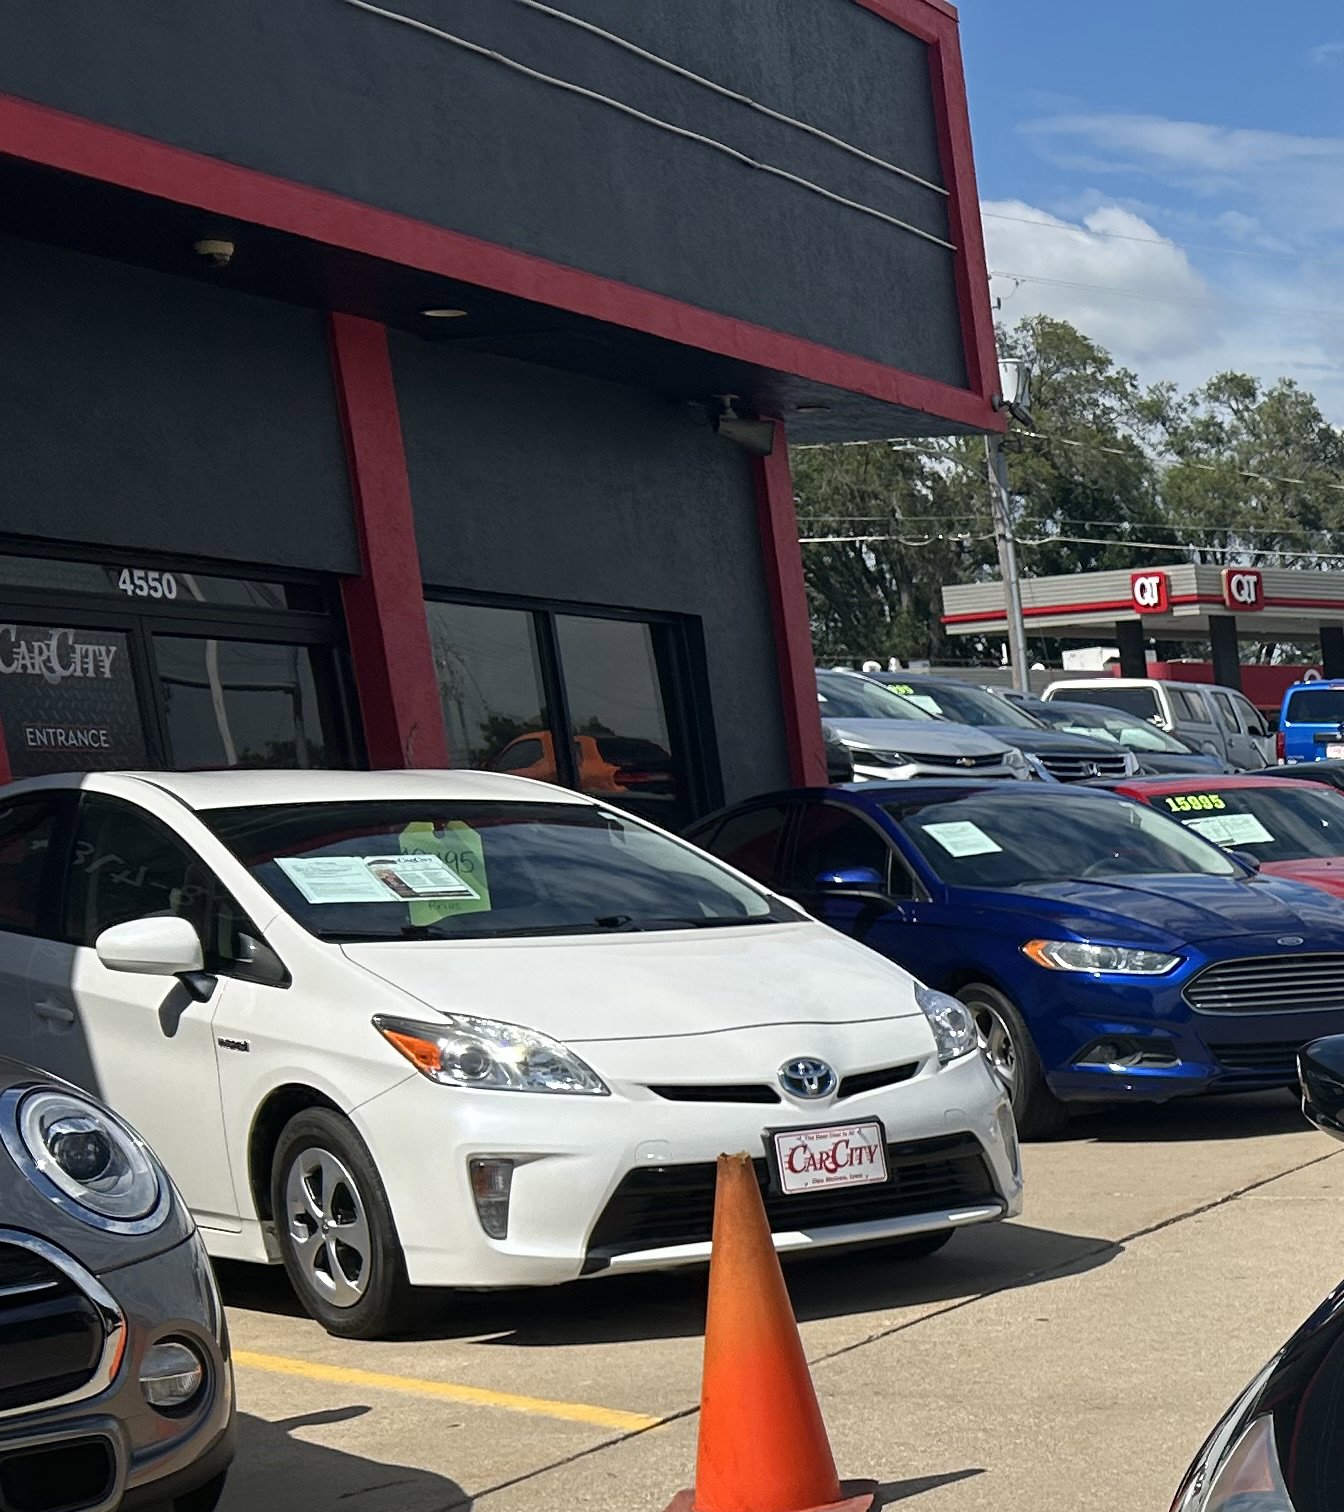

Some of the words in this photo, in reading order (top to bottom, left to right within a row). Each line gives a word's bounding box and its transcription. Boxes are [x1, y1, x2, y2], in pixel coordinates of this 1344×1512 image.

[118, 568, 177, 600] 4550
[1134, 576, 1160, 607] QT
[1230, 574, 1258, 605] QT
[26, 728, 110, 748] ENTRANCE
[1165, 793, 1226, 812] 15995
